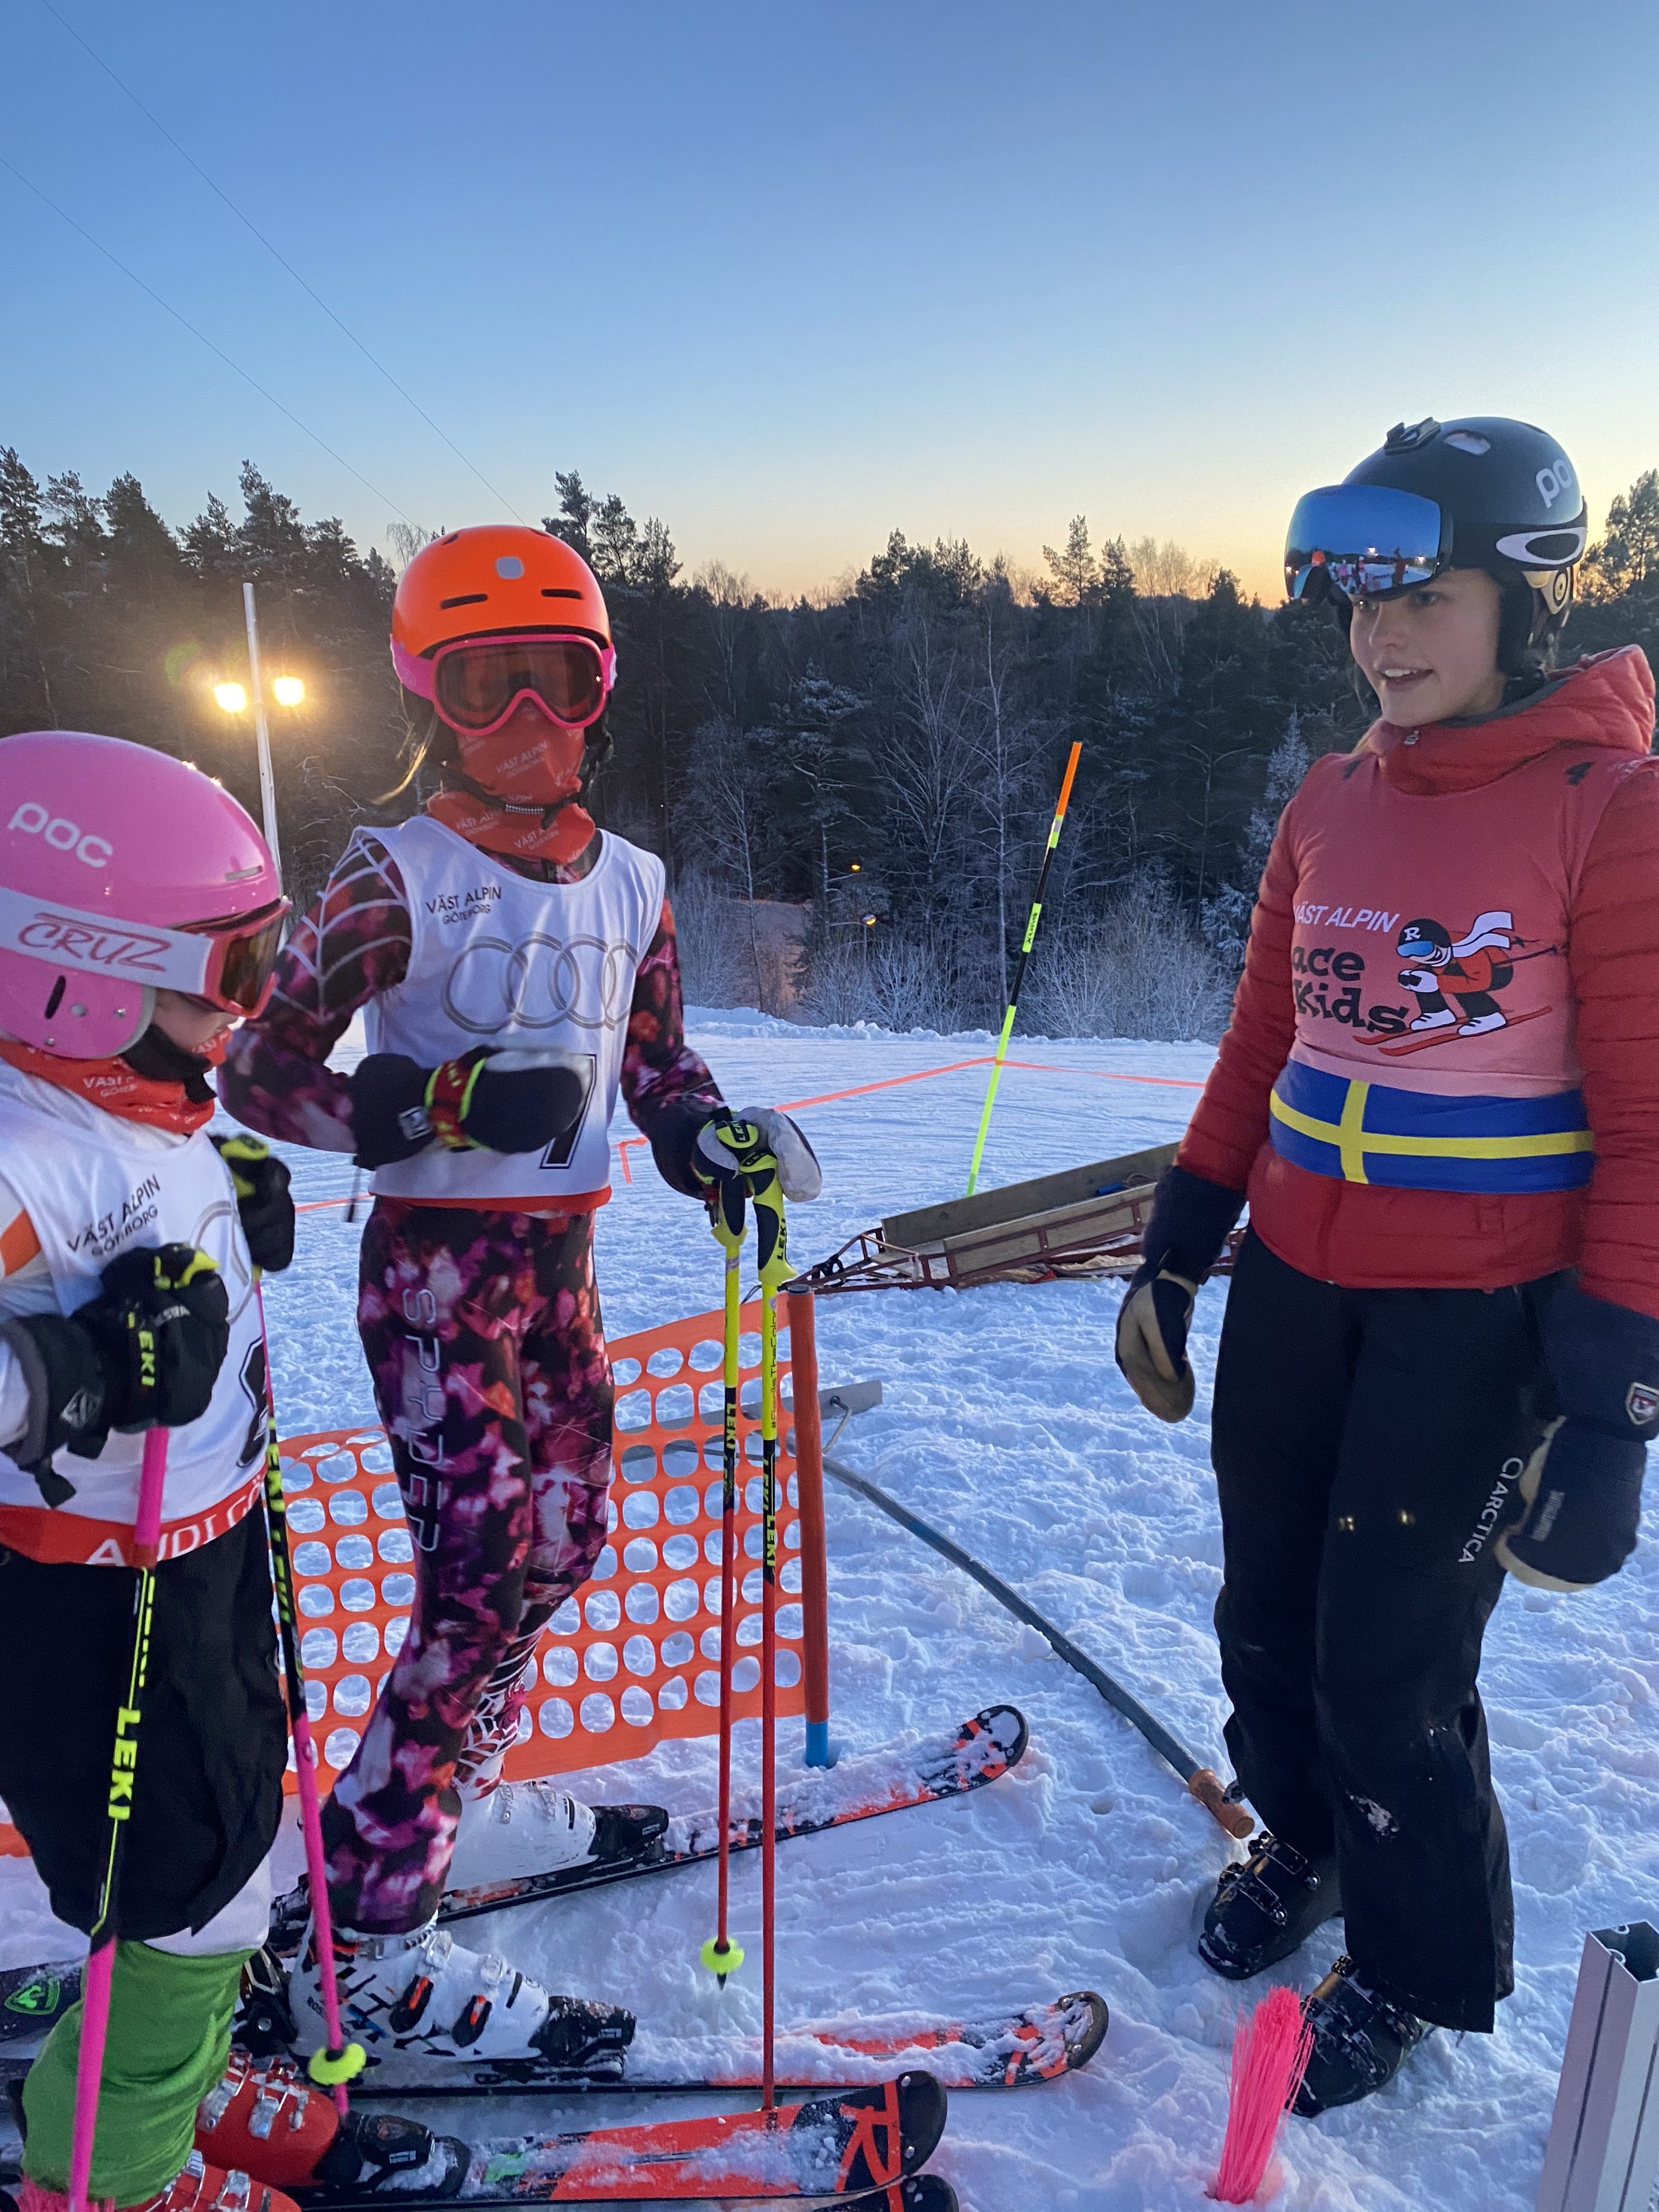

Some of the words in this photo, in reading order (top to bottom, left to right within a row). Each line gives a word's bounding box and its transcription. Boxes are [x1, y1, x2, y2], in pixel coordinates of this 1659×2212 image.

[1536, 459, 1573, 508] po
[425, 894, 460, 914] VÄST
[464, 886, 502, 906] ALPIN
[1324, 907, 1400, 933] ALPIN
[18, 912, 172, 973] CRUZ
[1403, 927, 1421, 941] R
[1292, 946, 1365, 981] ace
[1294, 979, 1410, 1034] Kids
[730, 1120, 747, 1141] LEKI
[67, 1212, 114, 1252] VÄST
[122, 1173, 161, 1224] ALPIN
[776, 1217, 787, 1261] LEKI
[402, 1288, 443, 1552] SPYDER
[726, 1402, 737, 1450] LEKI
[767, 1514, 777, 1567] LEKI
[108, 1706, 142, 1821] LEKI
